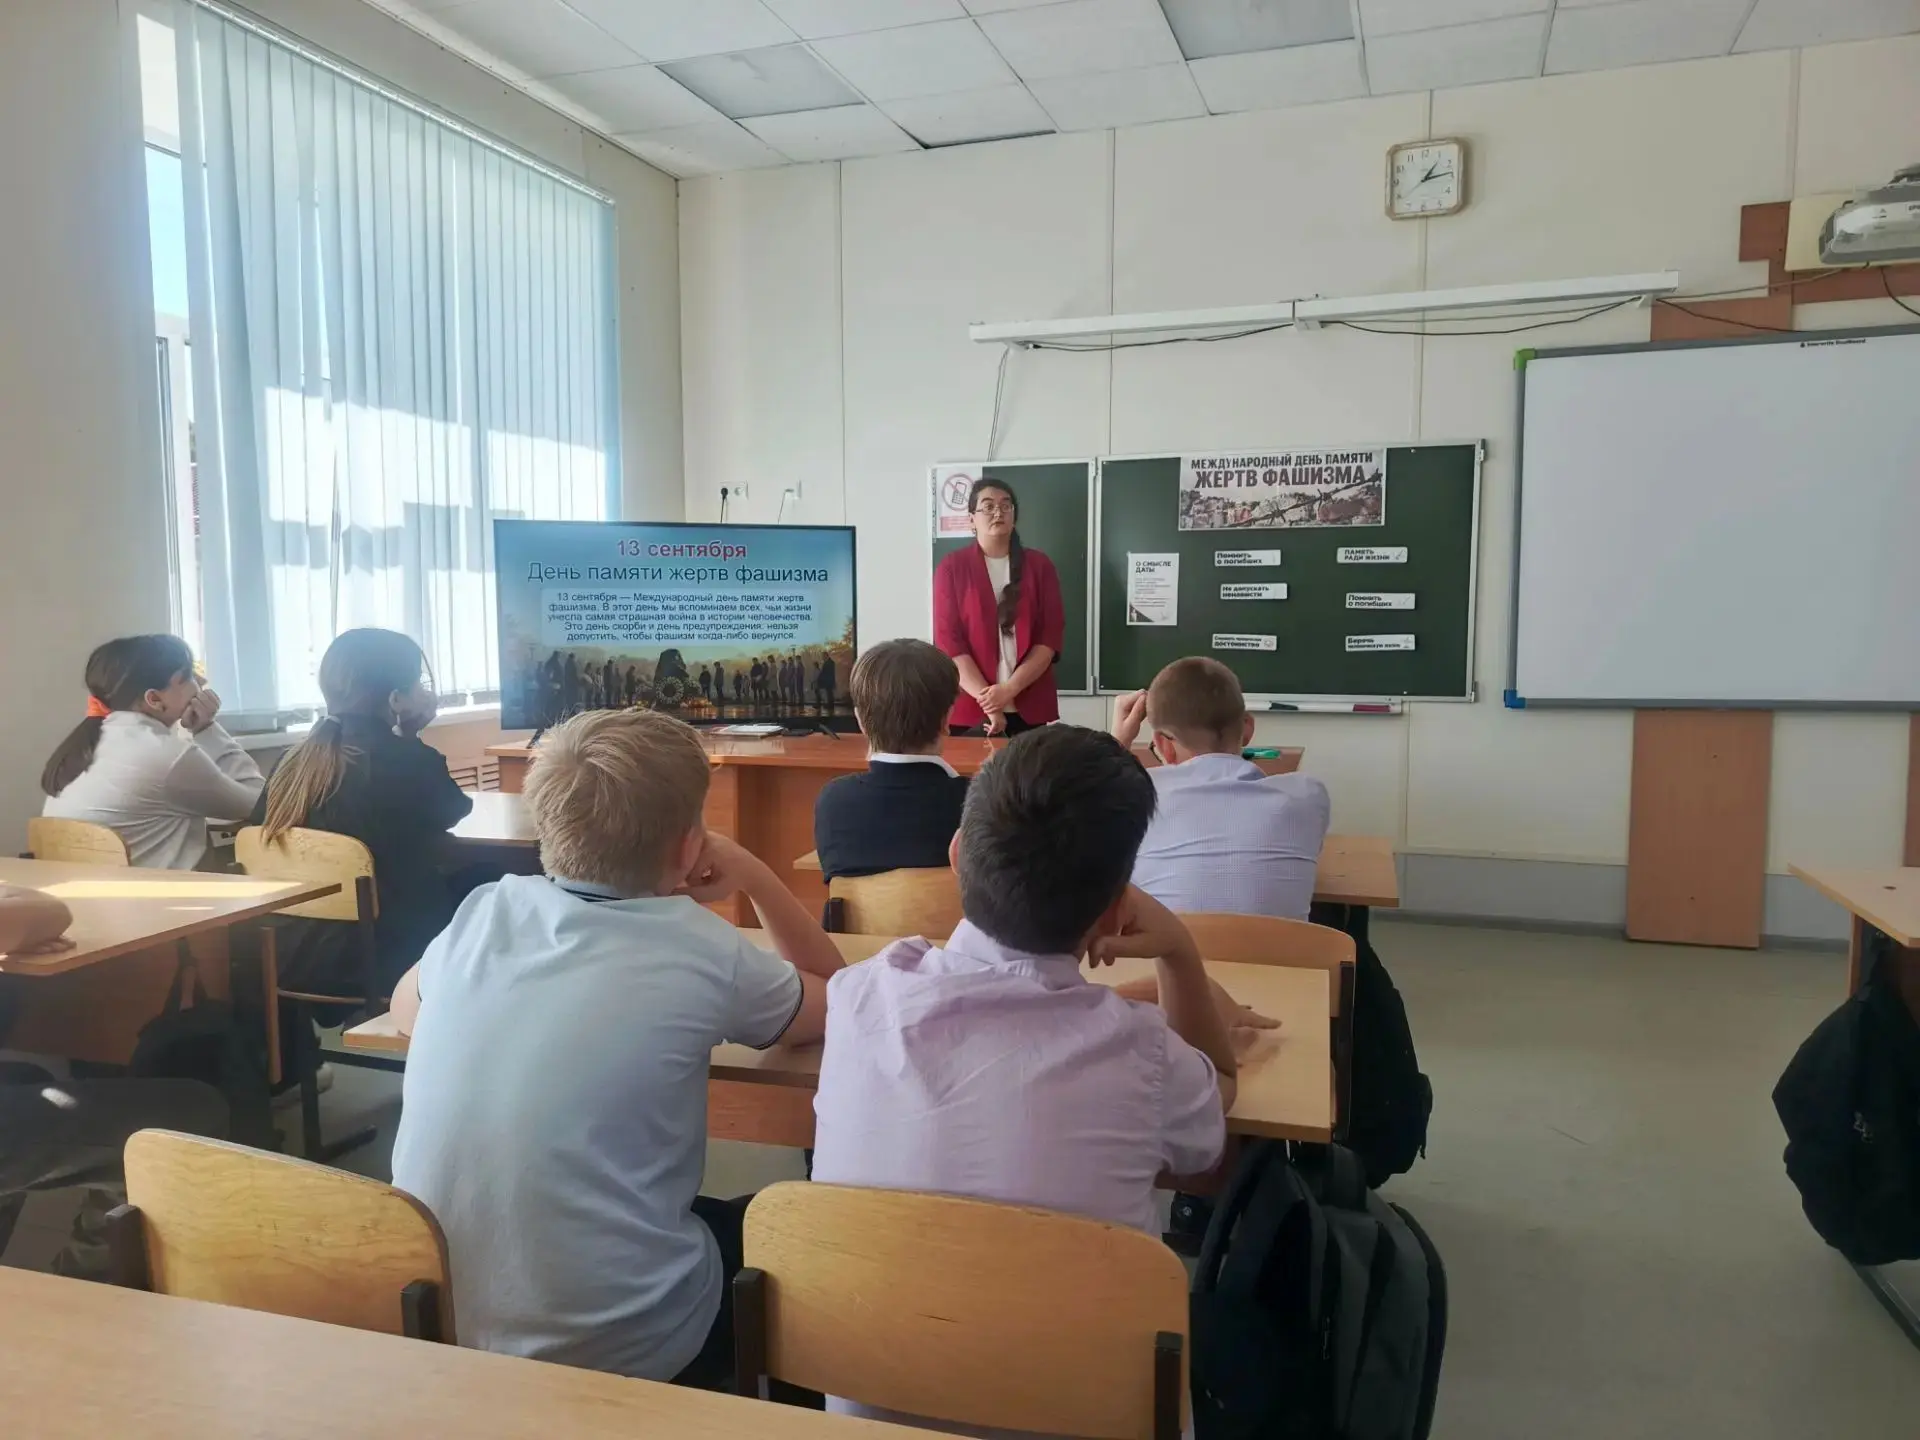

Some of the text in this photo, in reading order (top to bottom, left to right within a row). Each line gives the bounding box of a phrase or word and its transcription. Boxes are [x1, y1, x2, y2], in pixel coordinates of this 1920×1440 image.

[1191, 452, 1373, 469] МЕЖДУНАРОДНЫЙ ДЕНЬ ПАМЯТИ
[1194, 465, 1366, 488] ЖЕРТВ ФАШИЗМА
[617, 539, 747, 561] 13 сентября
[528, 562, 829, 584] День памяти жертв фашизма
[557, 592, 569, 601] 13
[571, 592, 617, 604] сентября
[633, 592, 713, 604] Международный
[716, 595, 739, 603] день
[777, 595, 804, 603] жертв
[602, 603, 609, 611] В
[635, 604, 659, 613] день
[678, 604, 737, 612] вспоминаем
[618, 614, 666, 622] страшная
[668, 613, 697, 621] война
[708, 614, 745, 622] истории
[564, 622, 583, 631] Это
[585, 623, 610, 632] день
[612, 622, 646, 632] скорби
[656, 623, 680, 632] день
[622, 632, 652, 640] чтобы
[655, 632, 695, 642] фашизм
[697, 631, 749, 641] когда-либо
